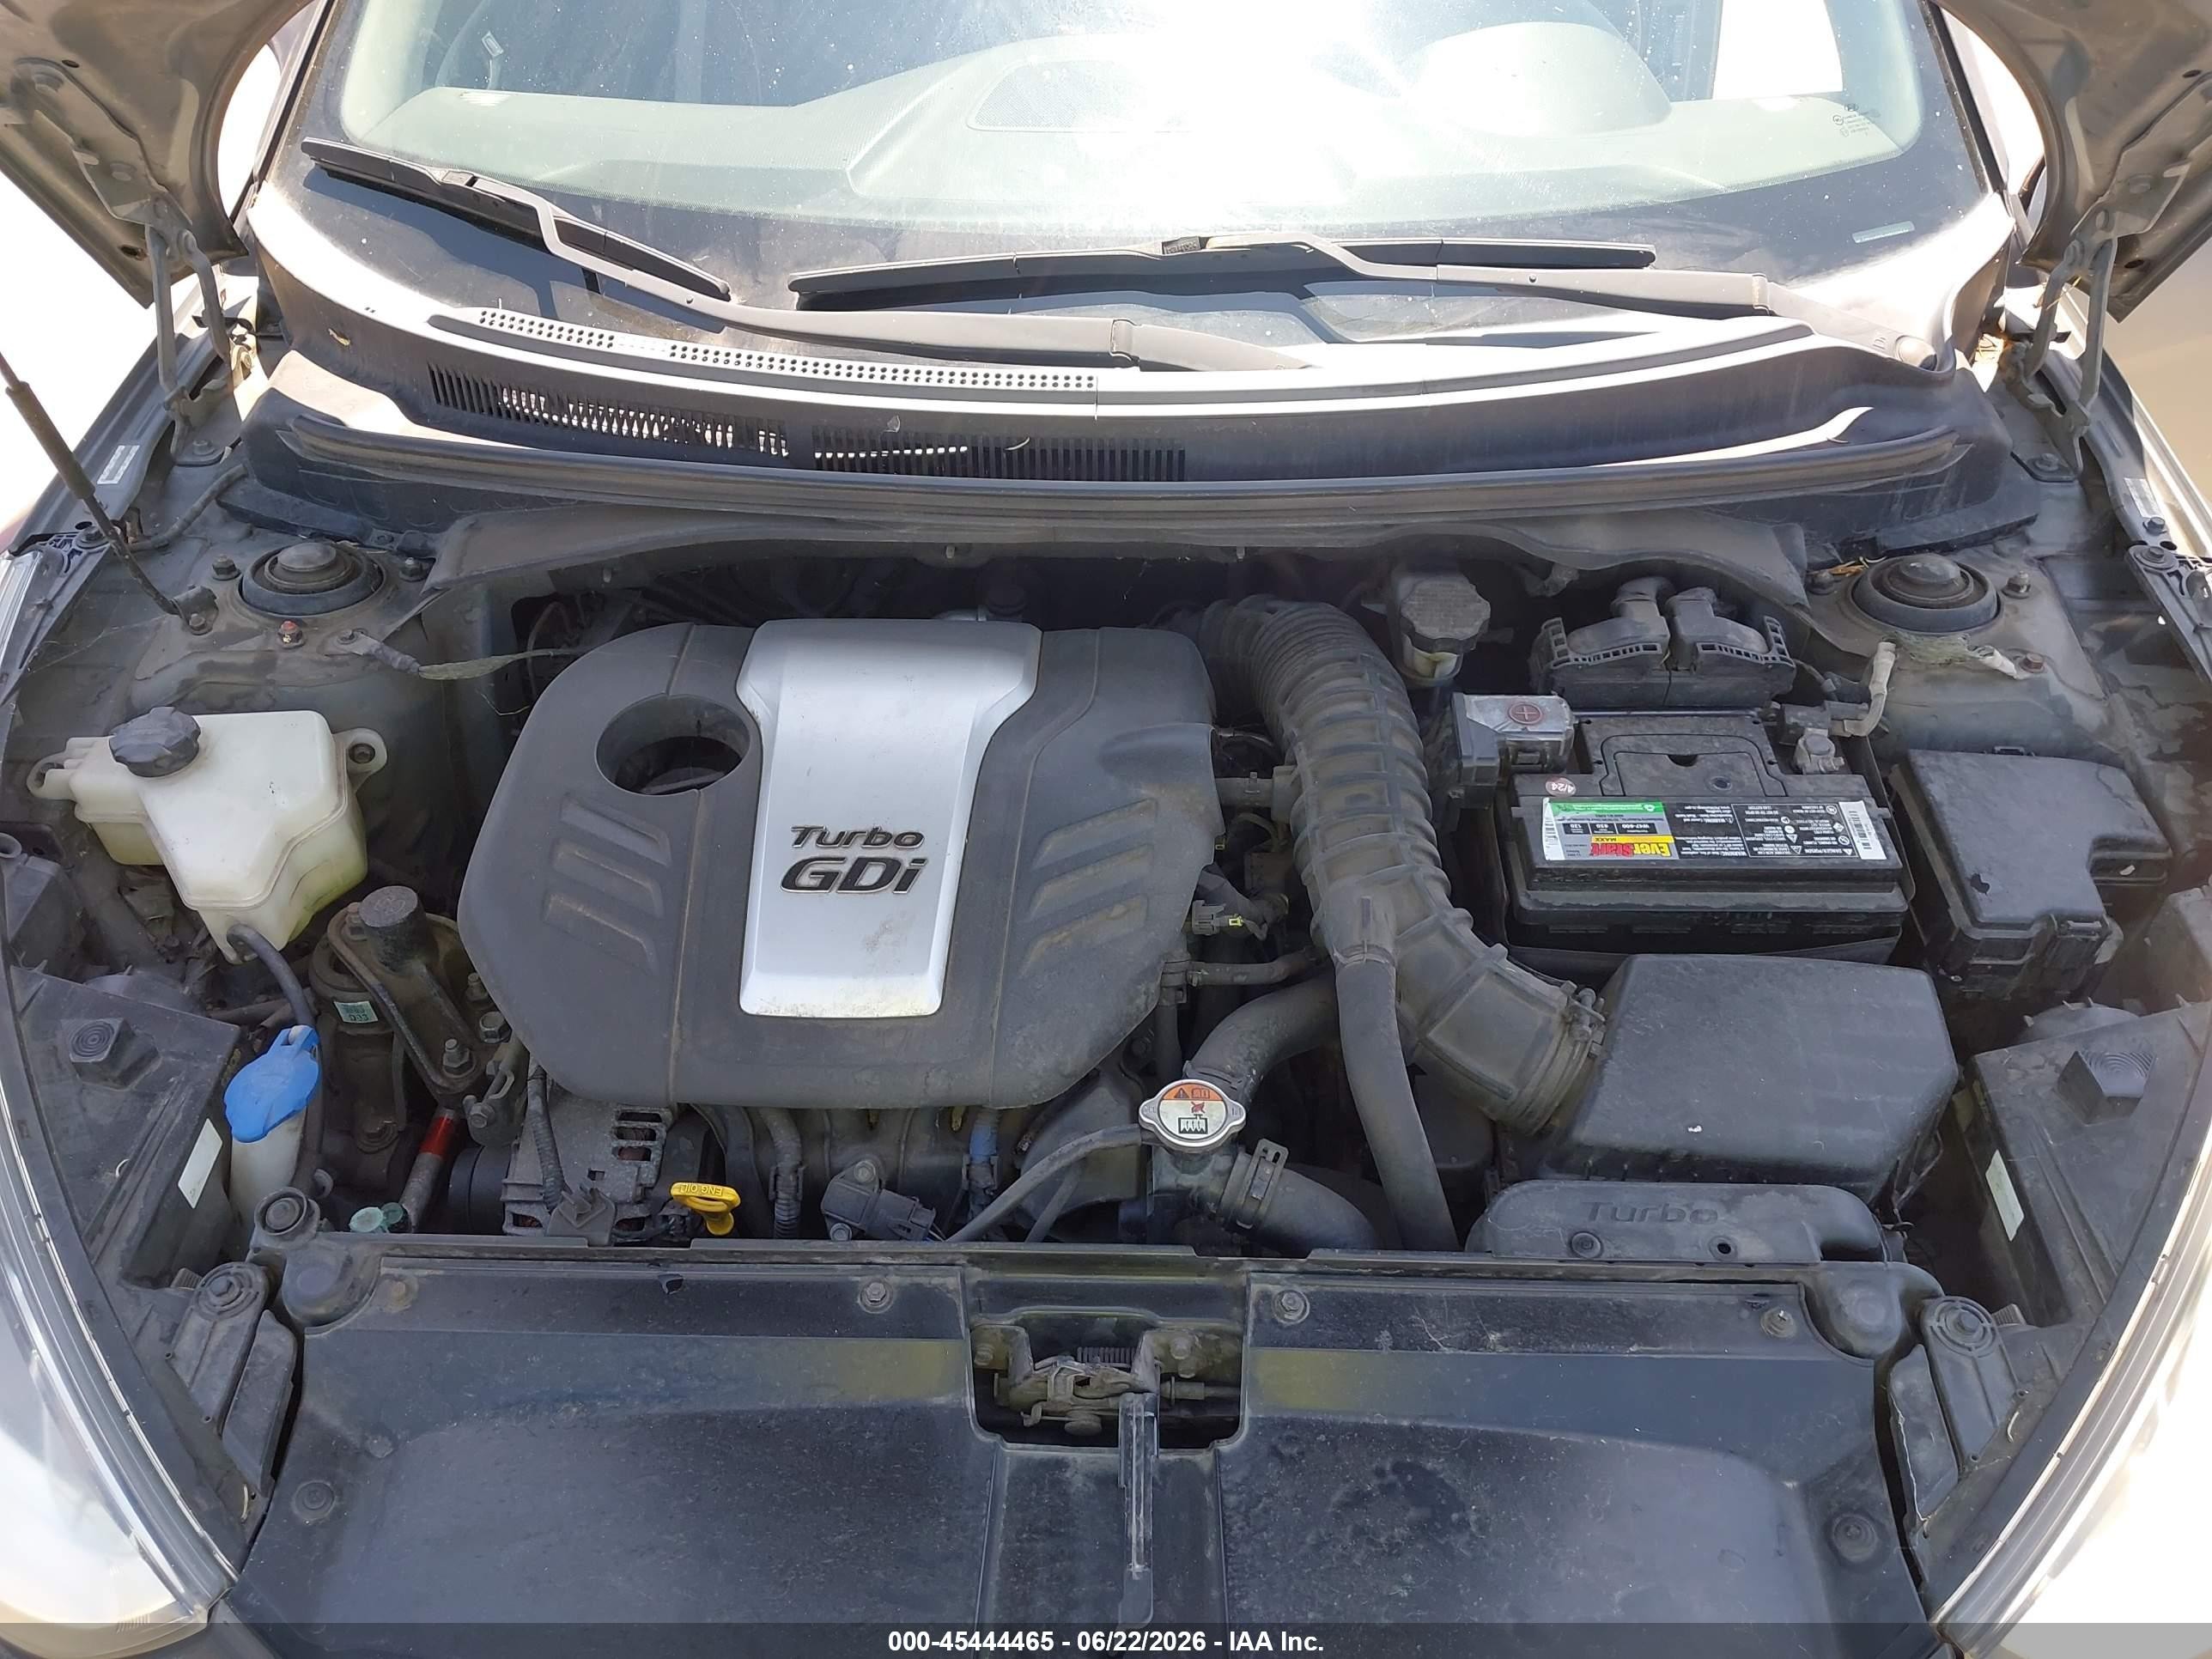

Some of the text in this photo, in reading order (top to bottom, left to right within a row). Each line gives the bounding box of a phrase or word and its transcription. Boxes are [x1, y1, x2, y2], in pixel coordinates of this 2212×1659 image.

[790, 825, 925, 849] Turbo
[1590, 842, 1672, 857] EverStart
[781, 856, 927, 894] GDi
[679, 1183, 722, 1196] ENG OIL
[1580, 1201, 1718, 1224] Turbo
